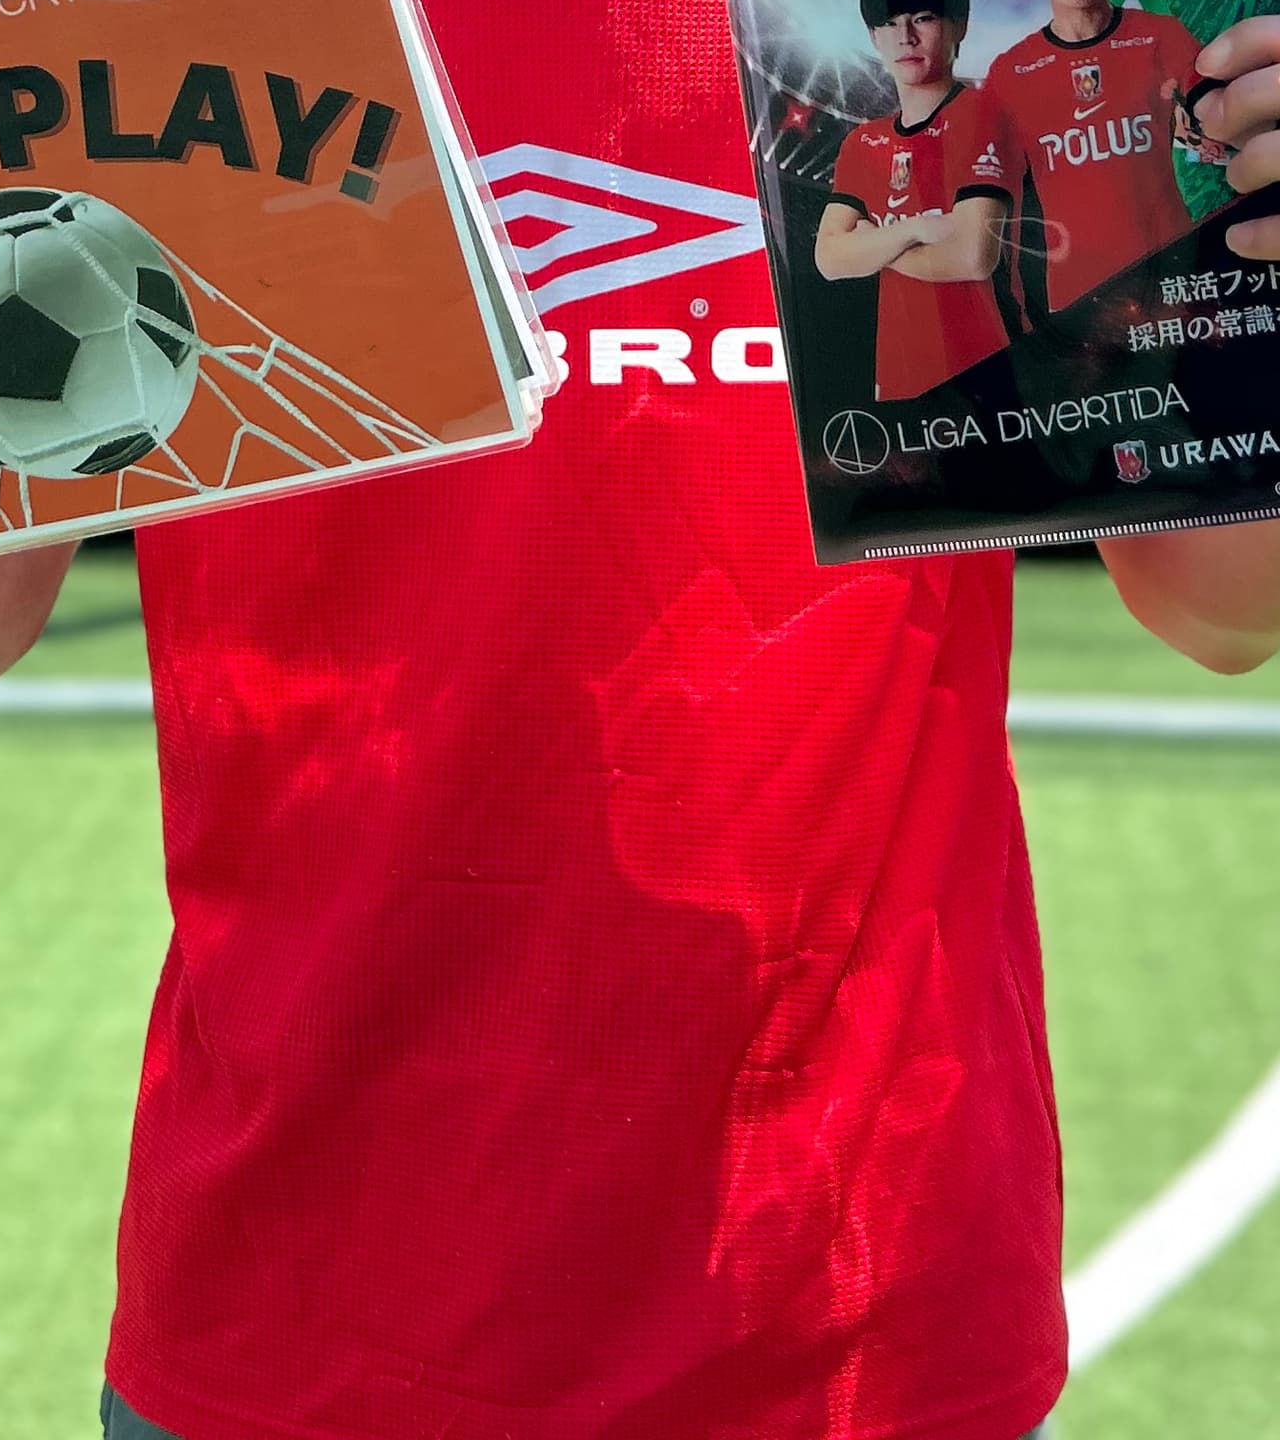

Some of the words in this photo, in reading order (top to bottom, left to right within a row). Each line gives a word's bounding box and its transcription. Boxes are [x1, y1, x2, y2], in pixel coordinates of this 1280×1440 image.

[1037, 113, 1153, 172] POLUS
[544, 325, 790, 386] RO
[1159, 429, 1280, 469] URAWA
